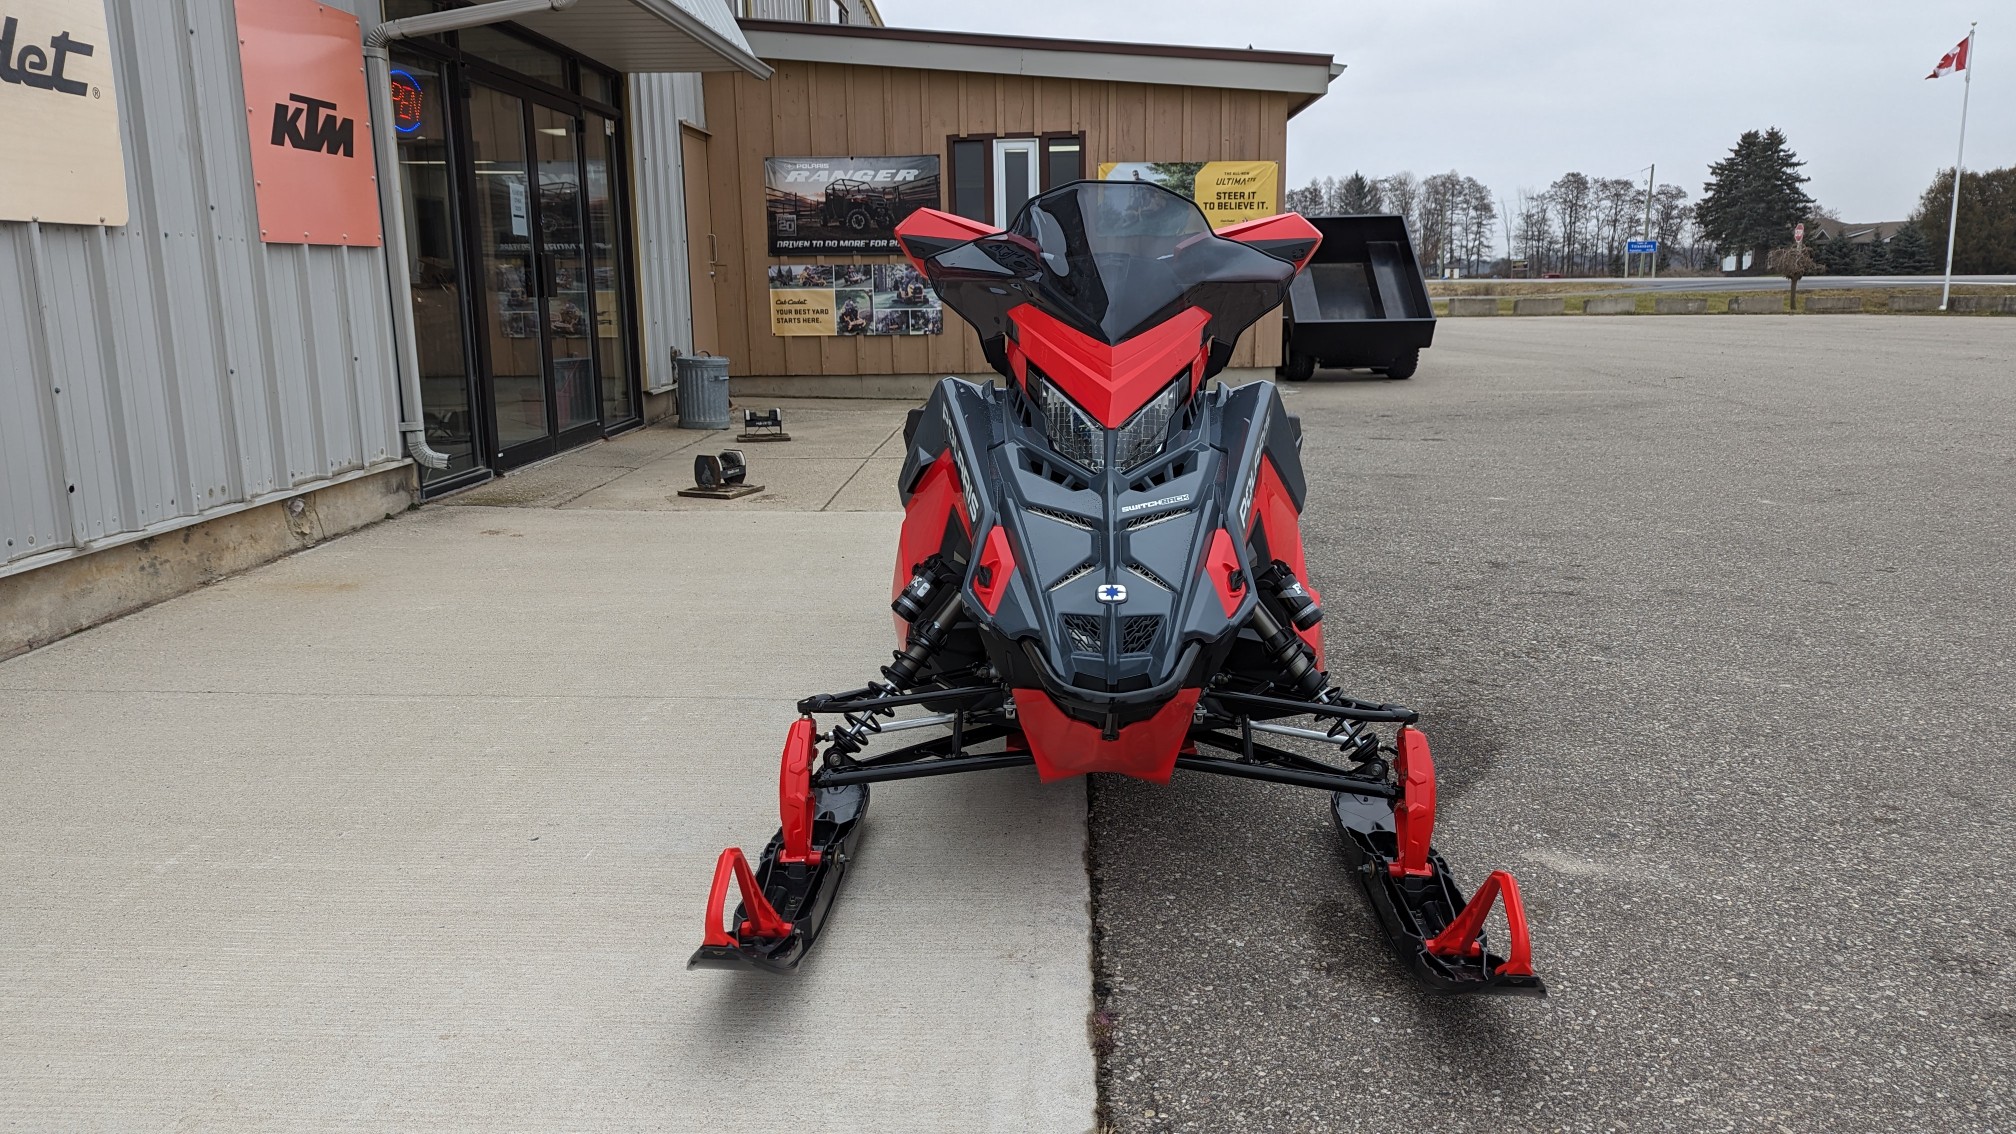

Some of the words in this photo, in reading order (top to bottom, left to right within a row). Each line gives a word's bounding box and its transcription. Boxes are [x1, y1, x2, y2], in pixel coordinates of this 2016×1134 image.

[392, 82, 423, 121] PEN
[271, 93, 353, 158] KTM
[785, 169, 919, 182] RANGER
[1216, 191, 1245, 200] STEER
[1248, 191, 1256, 200] IT
[1203, 202, 1215, 210] TO
[1218, 202, 1254, 210] BELIEVE
[1257, 202, 1268, 210] IT.
[777, 240, 810, 248] DRIVEN
[812, 240, 824, 248] TO
[942, 401, 979, 522] POLARIS
[1121, 494, 1190, 512] SWITCHBACK
